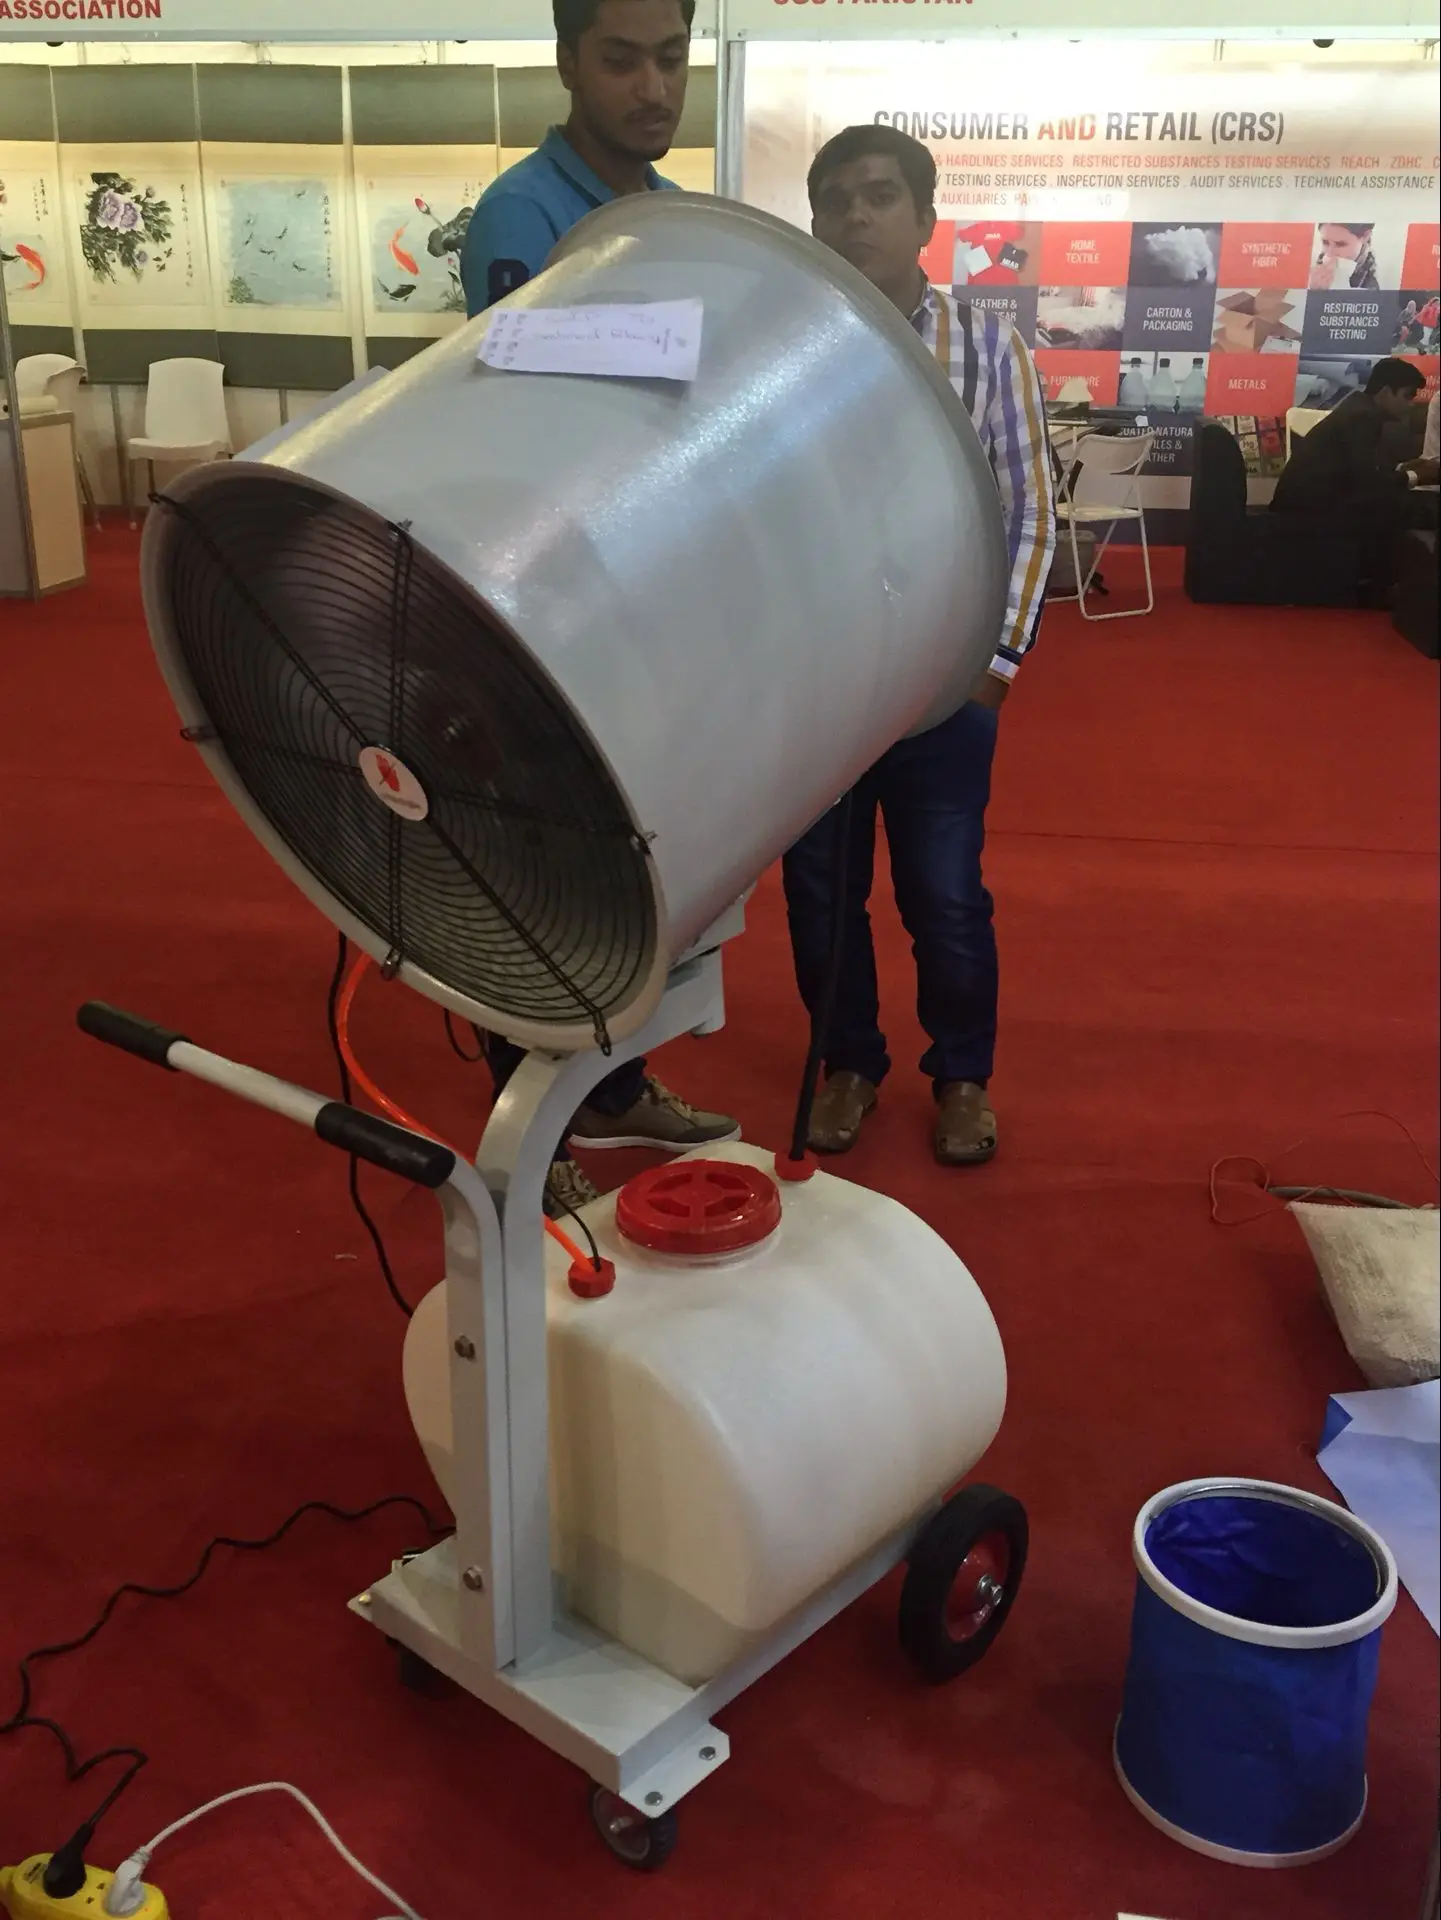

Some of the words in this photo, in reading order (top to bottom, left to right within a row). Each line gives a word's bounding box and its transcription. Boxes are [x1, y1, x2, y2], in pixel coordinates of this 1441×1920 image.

[0, 0, 162, 19] ASSOCIATION
[1037, 113, 1096, 140] AND
[1105, 112, 1202, 141] RETAIL
[1211, 112, 1284, 145] (CRS)
[946, 154, 1007, 167] HARDLINES
[1010, 155, 1063, 168] SERVICES
[1072, 155, 1142, 168] RESTRICTED
[1144, 155, 1220, 168] SUBSTANCES
[1225, 155, 1272, 169] TESTING
[1276, 156, 1331, 169] SERVICES
[1341, 156, 1380, 169] REACH
[945, 173, 991, 186] TESTING
[994, 174, 1047, 187] SERVICES
[1056, 174, 1123, 187] INSPECTION
[1126, 174, 1180, 188] SERVICES
[1190, 175, 1225, 188] AUDIT
[1228, 175, 1283, 188] SERVICES
[1294, 175, 1355, 189] TECHNICAL
[1361, 175, 1436, 189] ASSISTANCE
[940, 192, 1007, 205] AUXILIARIES
[1071, 239, 1096, 250] HOME
[1241, 243, 1292, 254] SYNTHETIC
[1066, 253, 1100, 264] TEXTILE
[1252, 257, 1278, 268] FIBER
[1010, 299, 1018, 309] &
[1323, 303, 1379, 314] RESTRICTED
[1146, 307, 1182, 318] CARTON
[1184, 308, 1192, 318] &
[1143, 320, 1193, 331] PACKAGING
[1319, 316, 1379, 327] SUBSTANCES
[1329, 329, 1367, 340] TESTING
[1228, 379, 1267, 390] METALS
[1155, 426, 1194, 437] NATURA
